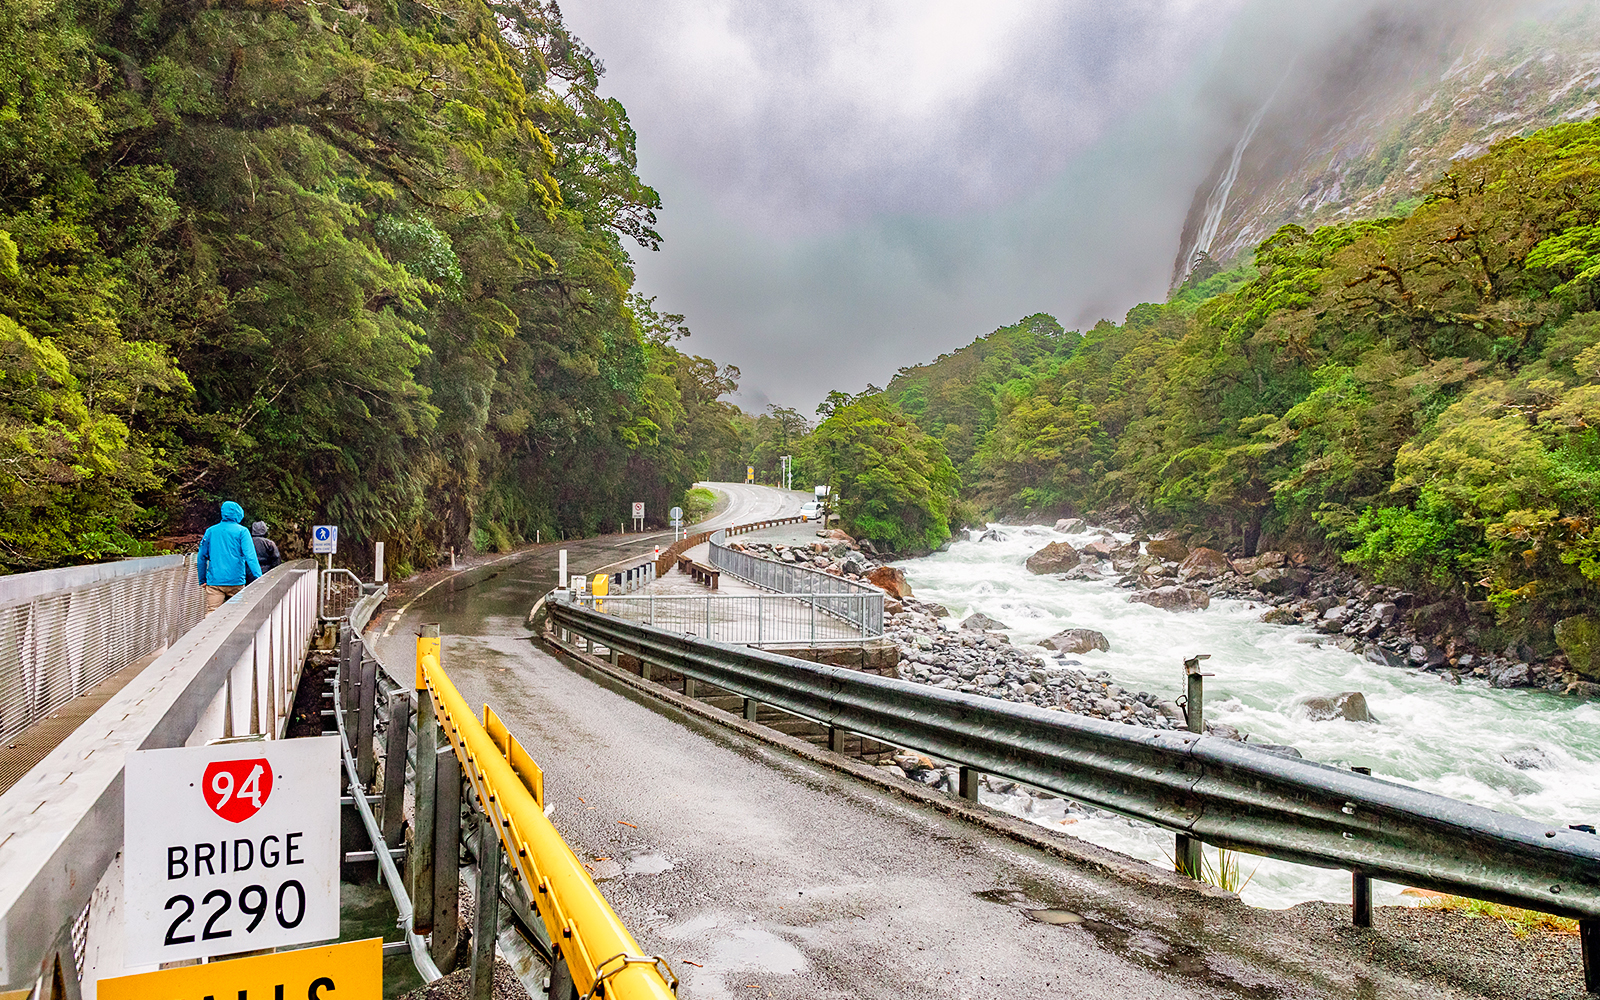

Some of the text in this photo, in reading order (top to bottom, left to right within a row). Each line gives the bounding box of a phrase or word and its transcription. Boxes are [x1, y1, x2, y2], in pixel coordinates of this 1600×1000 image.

[212, 764, 264, 810] 94
[167, 832, 304, 880] BRIDGE
[163, 879, 306, 946] 2290
